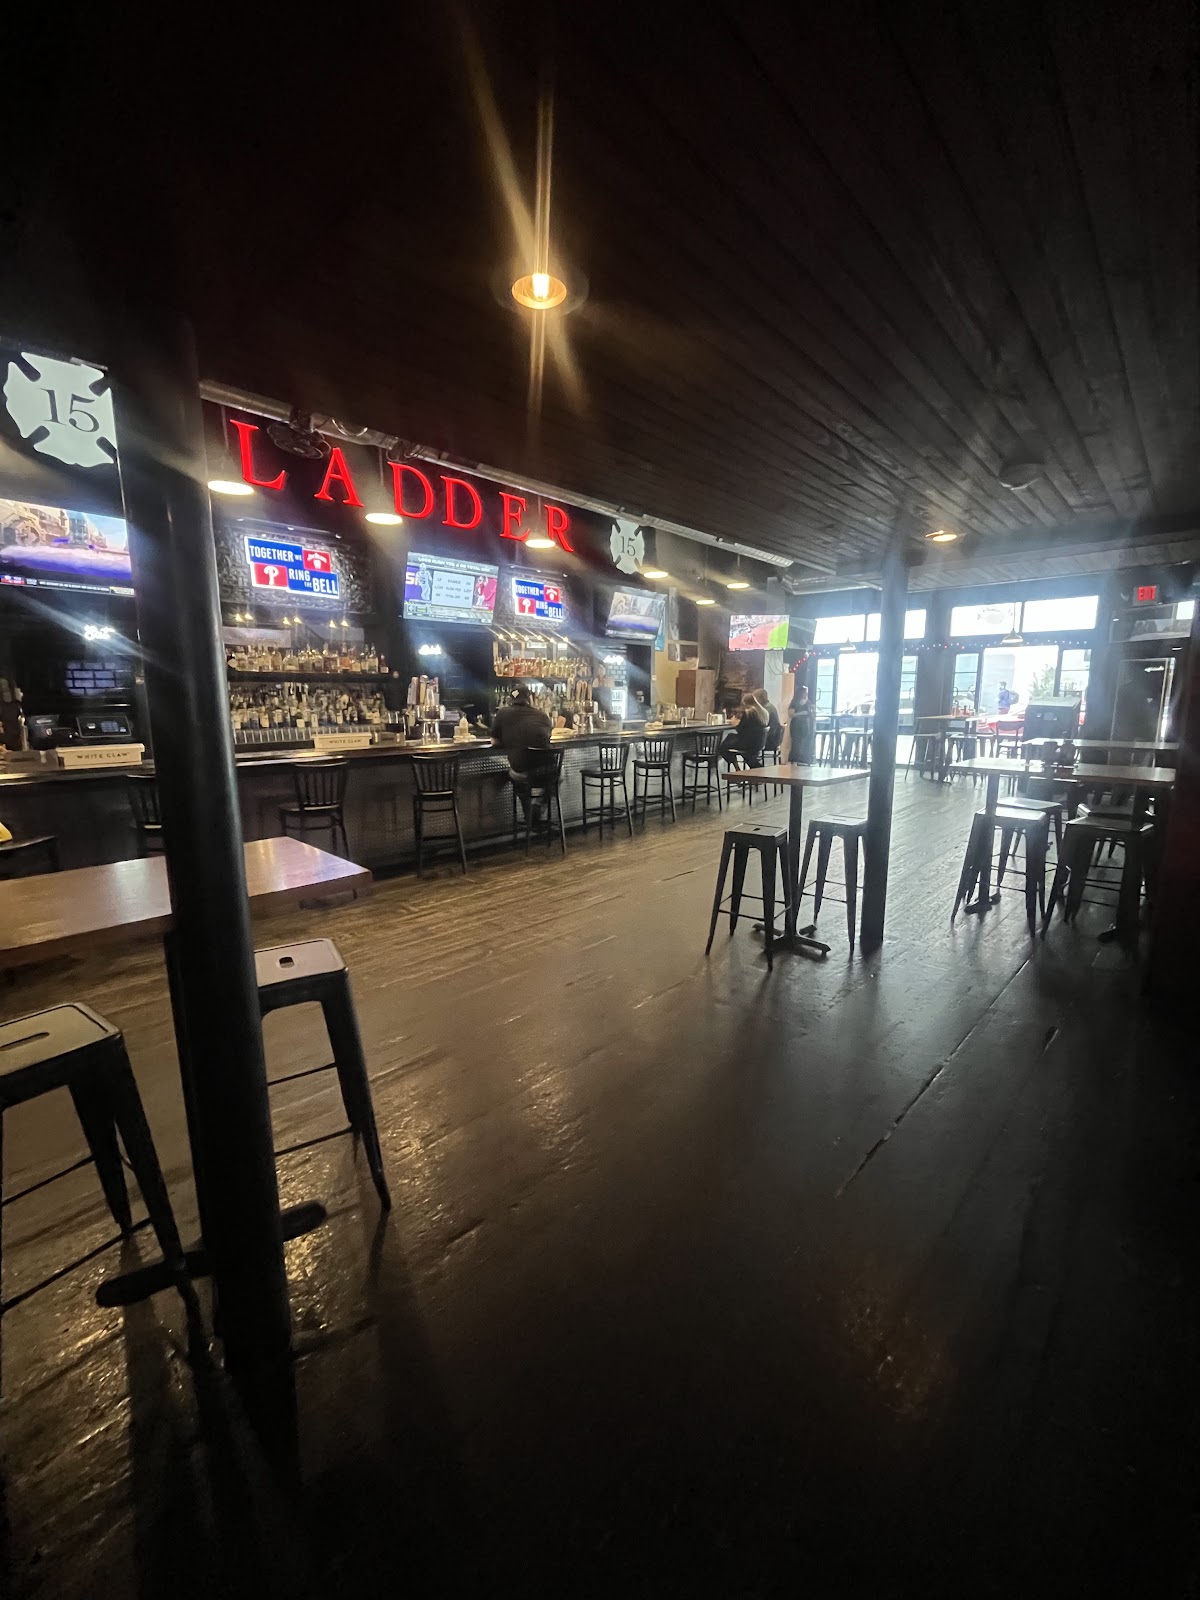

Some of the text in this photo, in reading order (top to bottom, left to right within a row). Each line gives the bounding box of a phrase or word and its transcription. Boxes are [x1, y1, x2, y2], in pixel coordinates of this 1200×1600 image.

[38, 387, 100, 433] 15
[229, 418, 575, 553] LADDER
[249, 545, 294, 562] TOGETHER
[619, 535, 636, 557] 15
[289, 568, 311, 581] RING
[312, 578, 337, 594] BELL
[515, 584, 539, 596] TOGETHER
[549, 606, 563, 619] BELL
